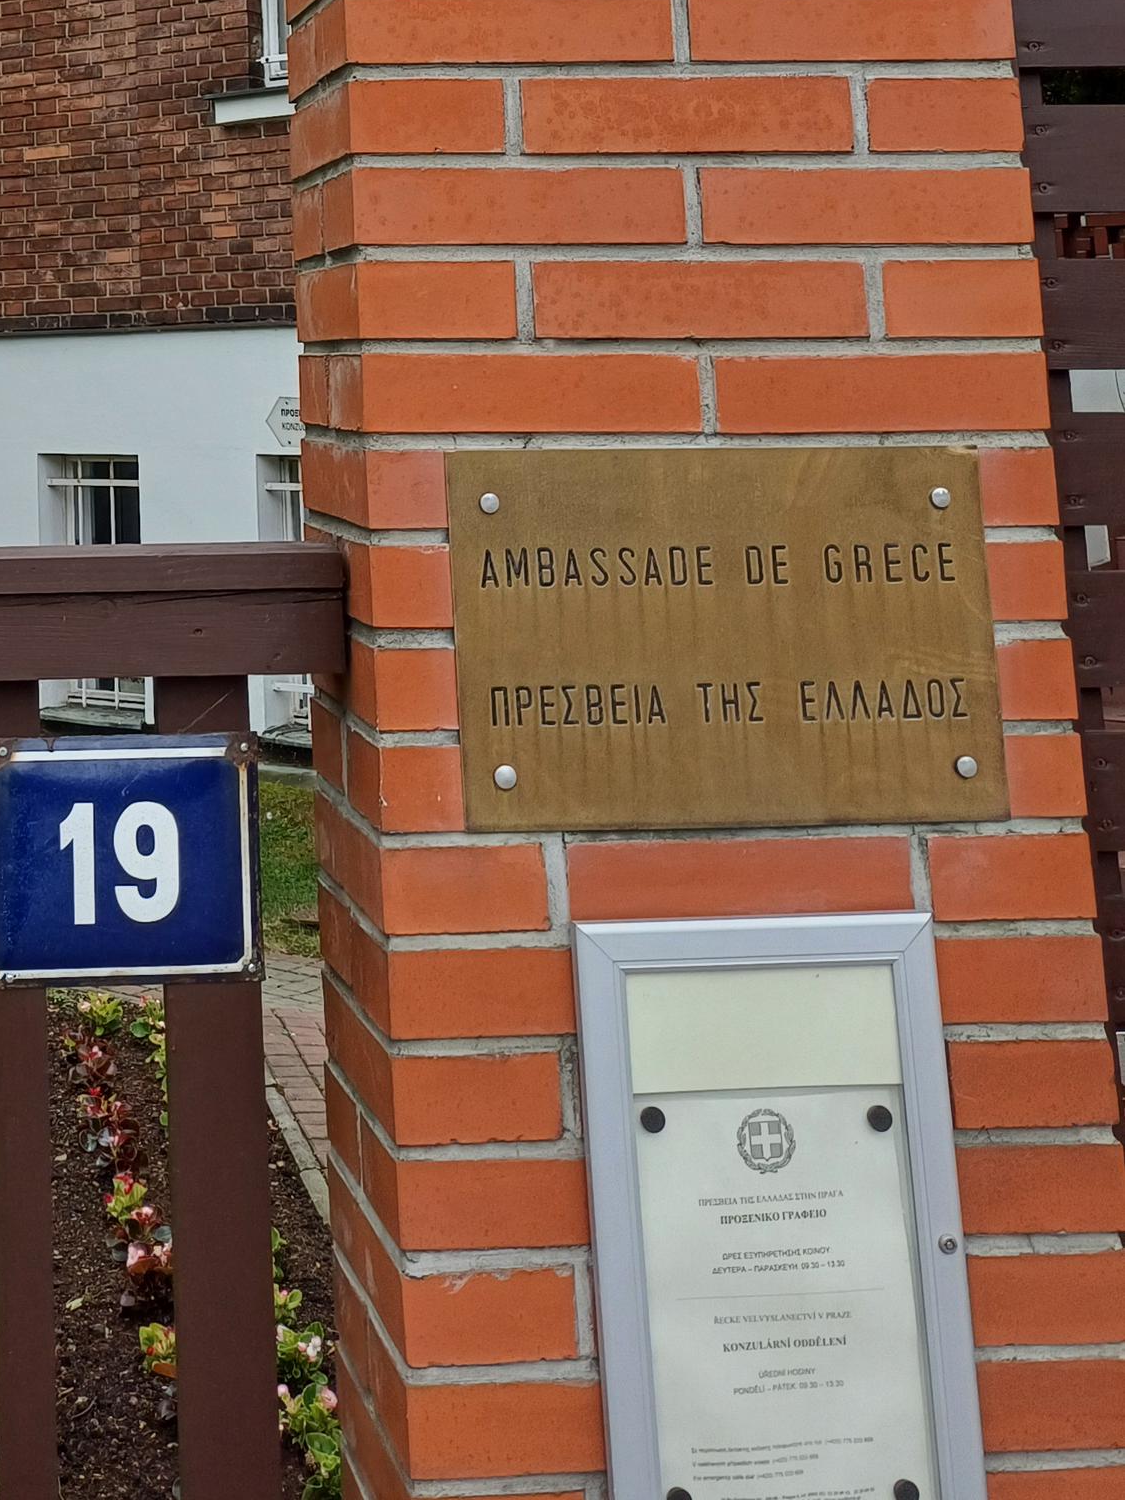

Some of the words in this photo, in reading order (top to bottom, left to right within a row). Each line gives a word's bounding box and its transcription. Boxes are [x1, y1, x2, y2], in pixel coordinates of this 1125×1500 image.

[480, 545, 714, 589] AMBASSADE
[745, 545, 789, 586] DE
[823, 542, 957, 585] GRECE
[490, 683, 668, 728] ΠΡΕΣΒΕΙΑ
[696, 681, 764, 724] ΤΗΣ
[800, 677, 970, 723] ΕΛΛΑΔΟΣ
[58, 800, 180, 926] 19
[720, 1211, 780, 1225] ΠΡΟΞΕΝΙΚΟ
[782, 1208, 827, 1221] ΓΡΑΦΕΙΟ
[723, 1337, 791, 1353] KONZULÁRNÍ
